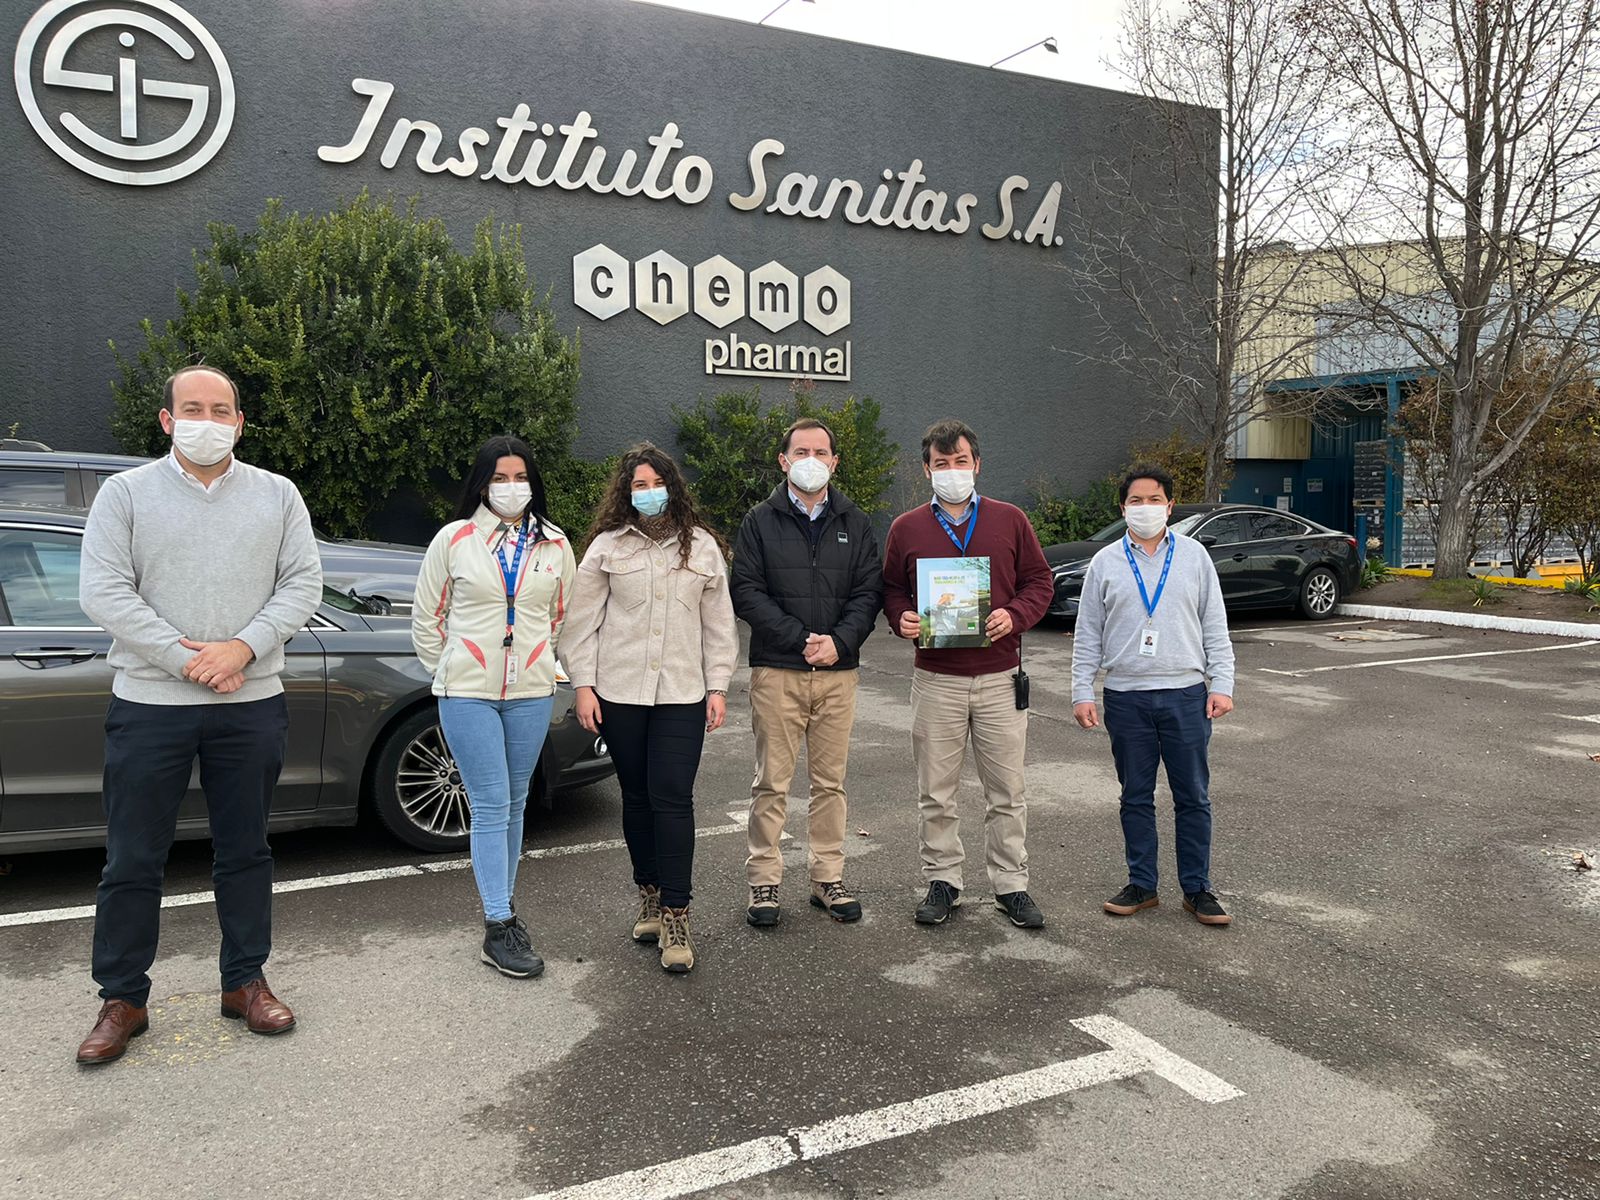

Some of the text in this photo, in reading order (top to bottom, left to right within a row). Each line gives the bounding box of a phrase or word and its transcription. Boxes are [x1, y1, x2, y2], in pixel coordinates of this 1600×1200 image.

[317, 77, 1064, 248] Instituto Sanitas S.A.
[588, 258, 840, 318] chemo
[705, 332, 846, 376] pharma
